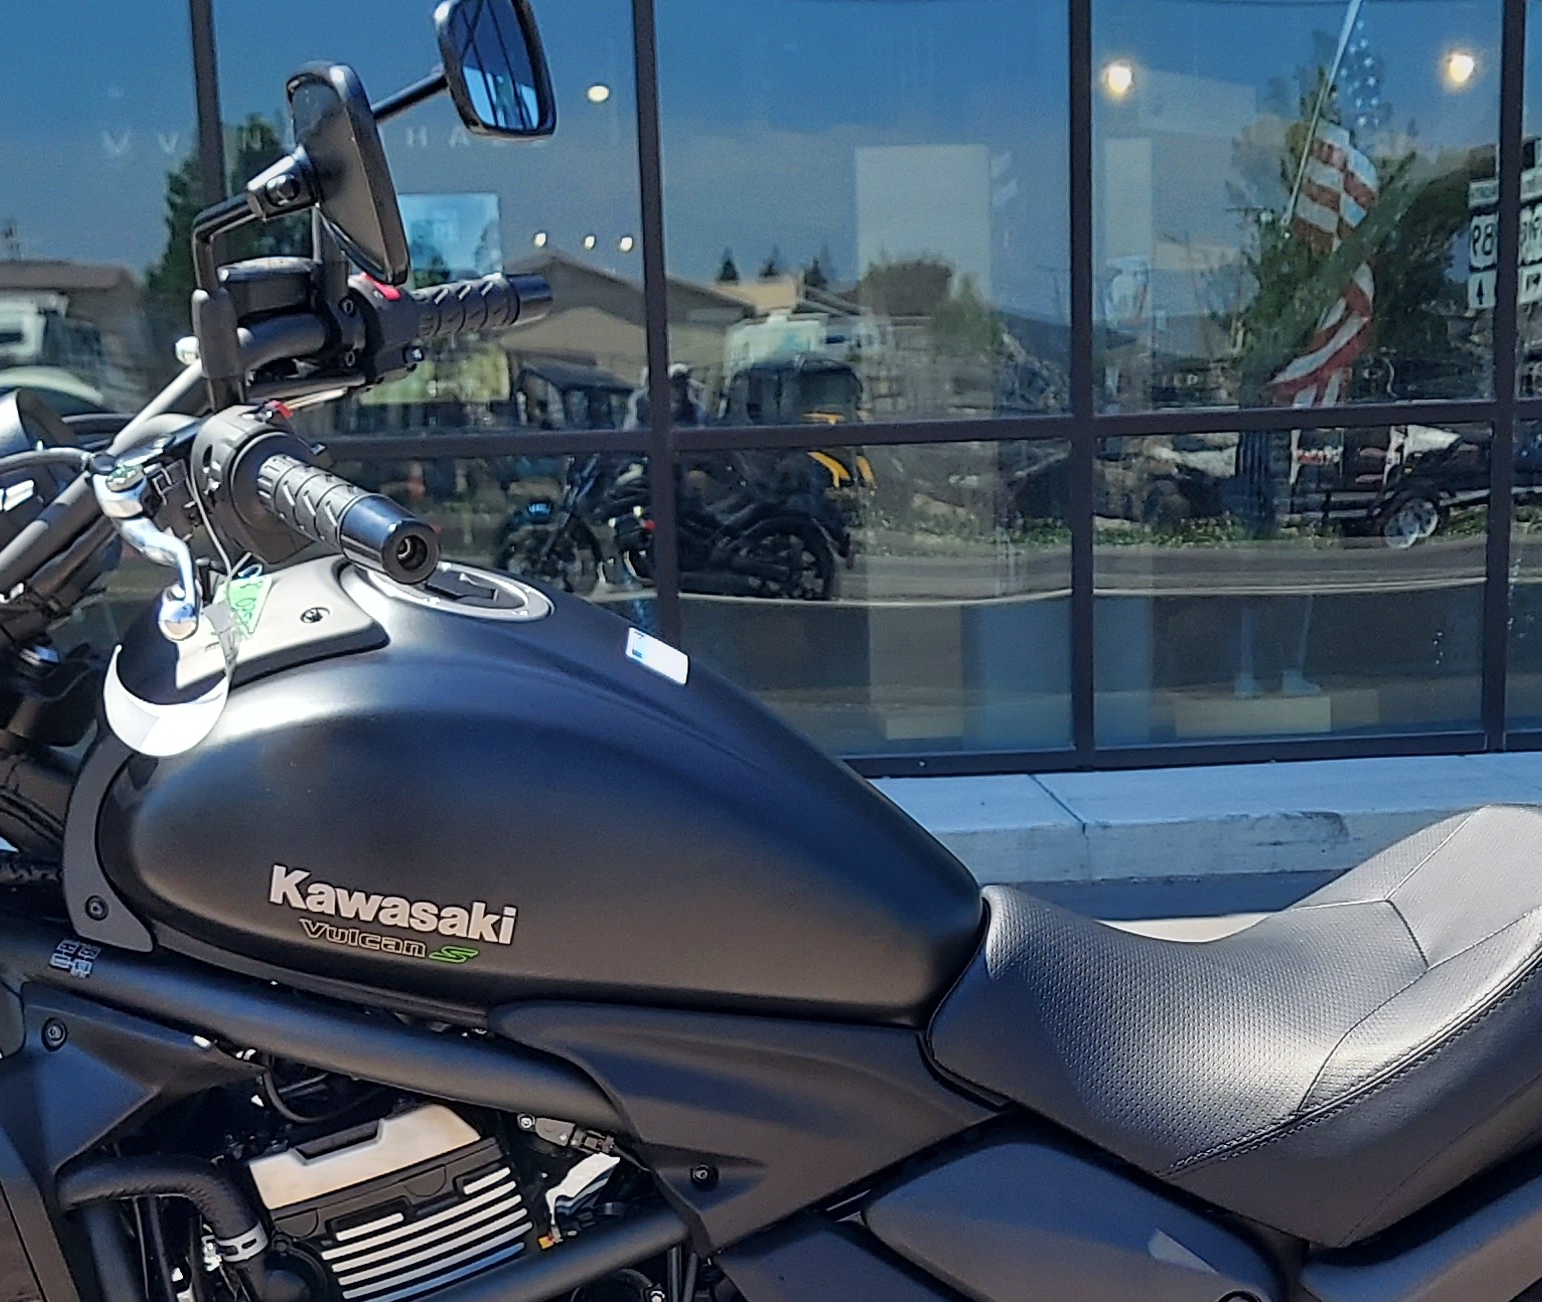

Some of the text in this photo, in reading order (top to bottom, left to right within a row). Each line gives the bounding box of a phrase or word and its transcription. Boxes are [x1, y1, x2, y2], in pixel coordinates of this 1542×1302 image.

[270, 864, 517, 945] Kawasaki
[299, 918, 479, 963] Vulcan S
